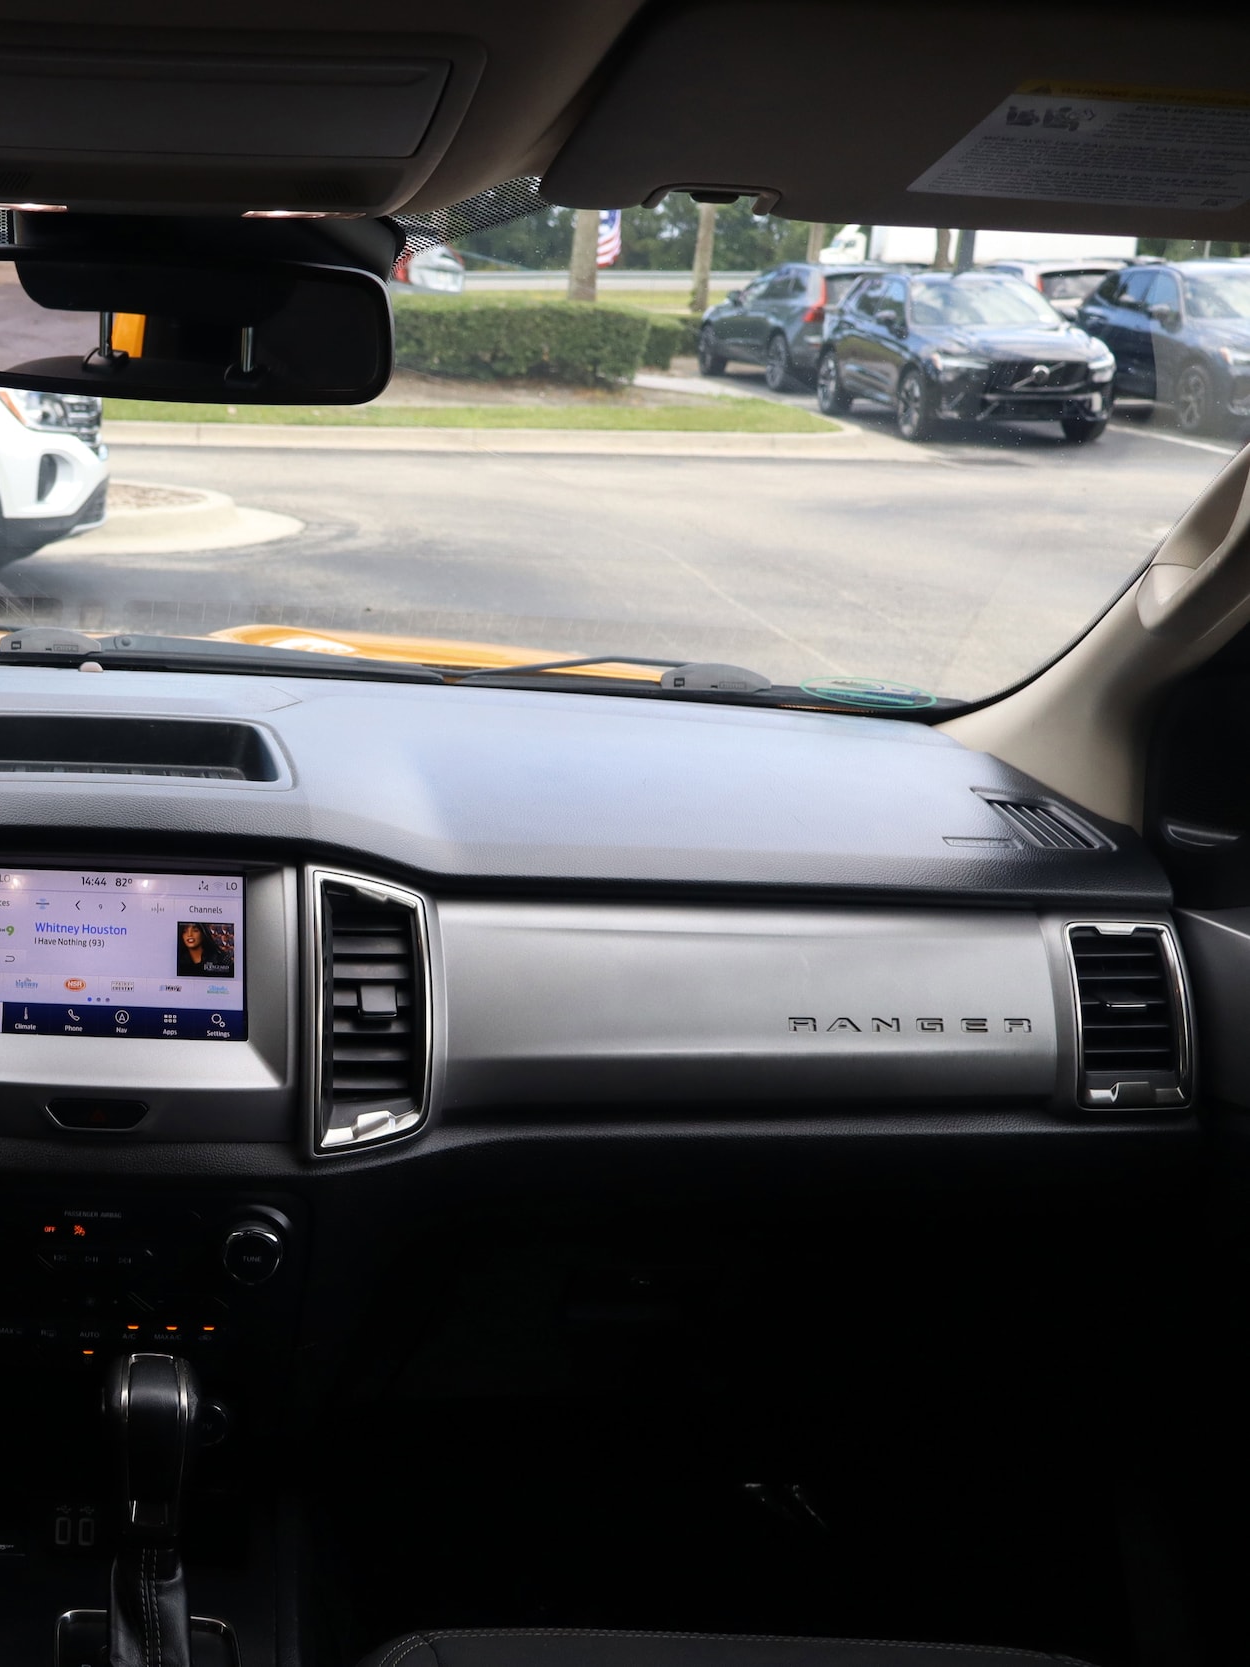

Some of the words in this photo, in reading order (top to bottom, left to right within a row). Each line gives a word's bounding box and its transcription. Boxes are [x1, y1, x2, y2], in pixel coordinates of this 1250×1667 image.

[0, 874, 11, 883] LO
[81, 876, 107, 886] 14:44
[226, 882, 238, 891] LO
[189, 905, 223, 914] Channels
[35, 922, 79, 935] Whitney
[82, 924, 127, 935] Houston
[58, 938, 86, 947] Nothing
[89, 939, 105, 948] (93)
[788, 1017, 1032, 1033] RANGER
[43, 1225, 56, 1233] OFF
